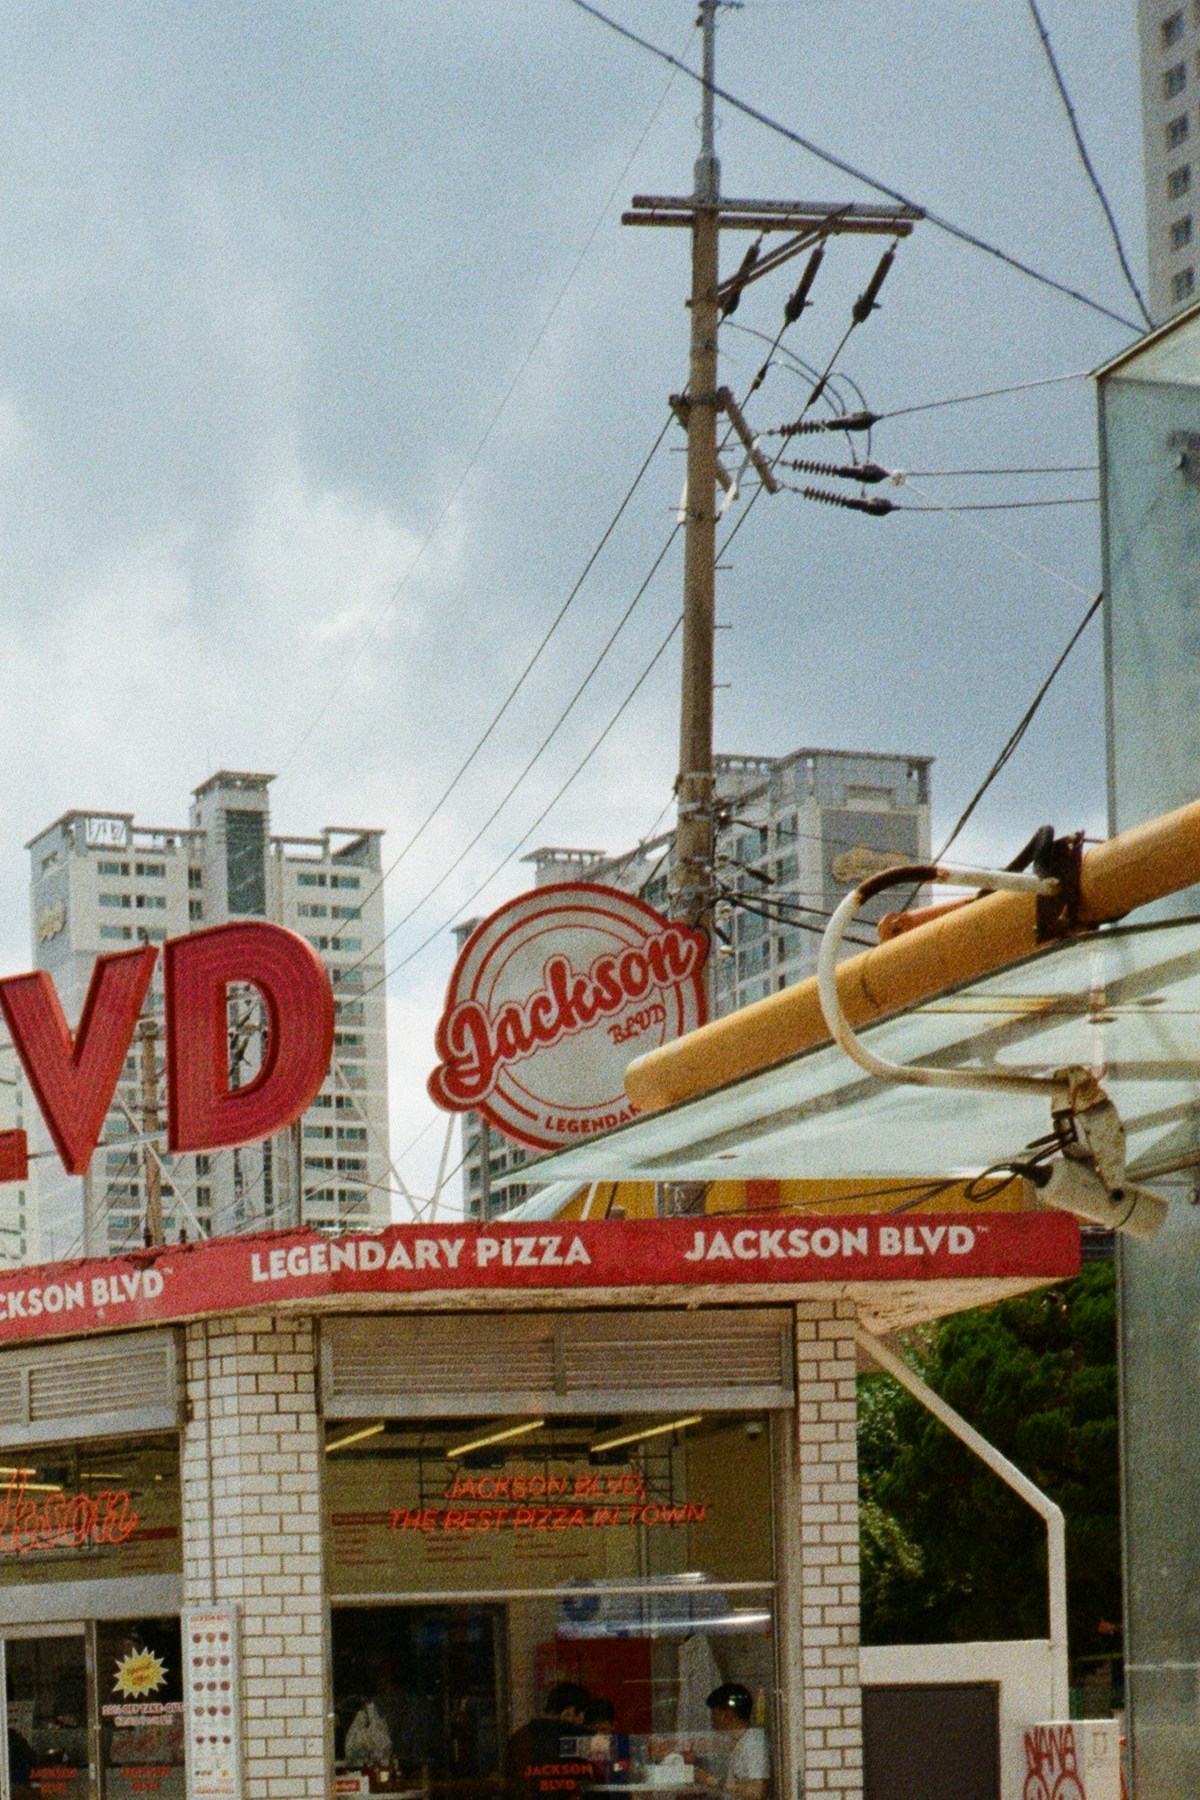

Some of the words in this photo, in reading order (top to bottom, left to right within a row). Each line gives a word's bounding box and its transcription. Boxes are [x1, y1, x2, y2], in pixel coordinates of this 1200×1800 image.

[440, 930, 696, 1100] Jackson
[607, 1003, 666, 1044] BLVD
[251, 1239, 462, 1283] LEGENDARY
[475, 1235, 592, 1268] PIZZA
[684, 1226, 870, 1262] JACKSON
[444, 1474, 567, 1501] JACKSON
[389, 1508, 437, 1532] THE
[444, 1508, 505, 1531] BEST
[512, 1508, 586, 1531] PIZZA
[593, 1508, 620, 1529] IN
[627, 1503, 708, 1527] TOWN
[524, 1763, 594, 1778] JACKSON
[539, 1779, 576, 1792] BLVD
